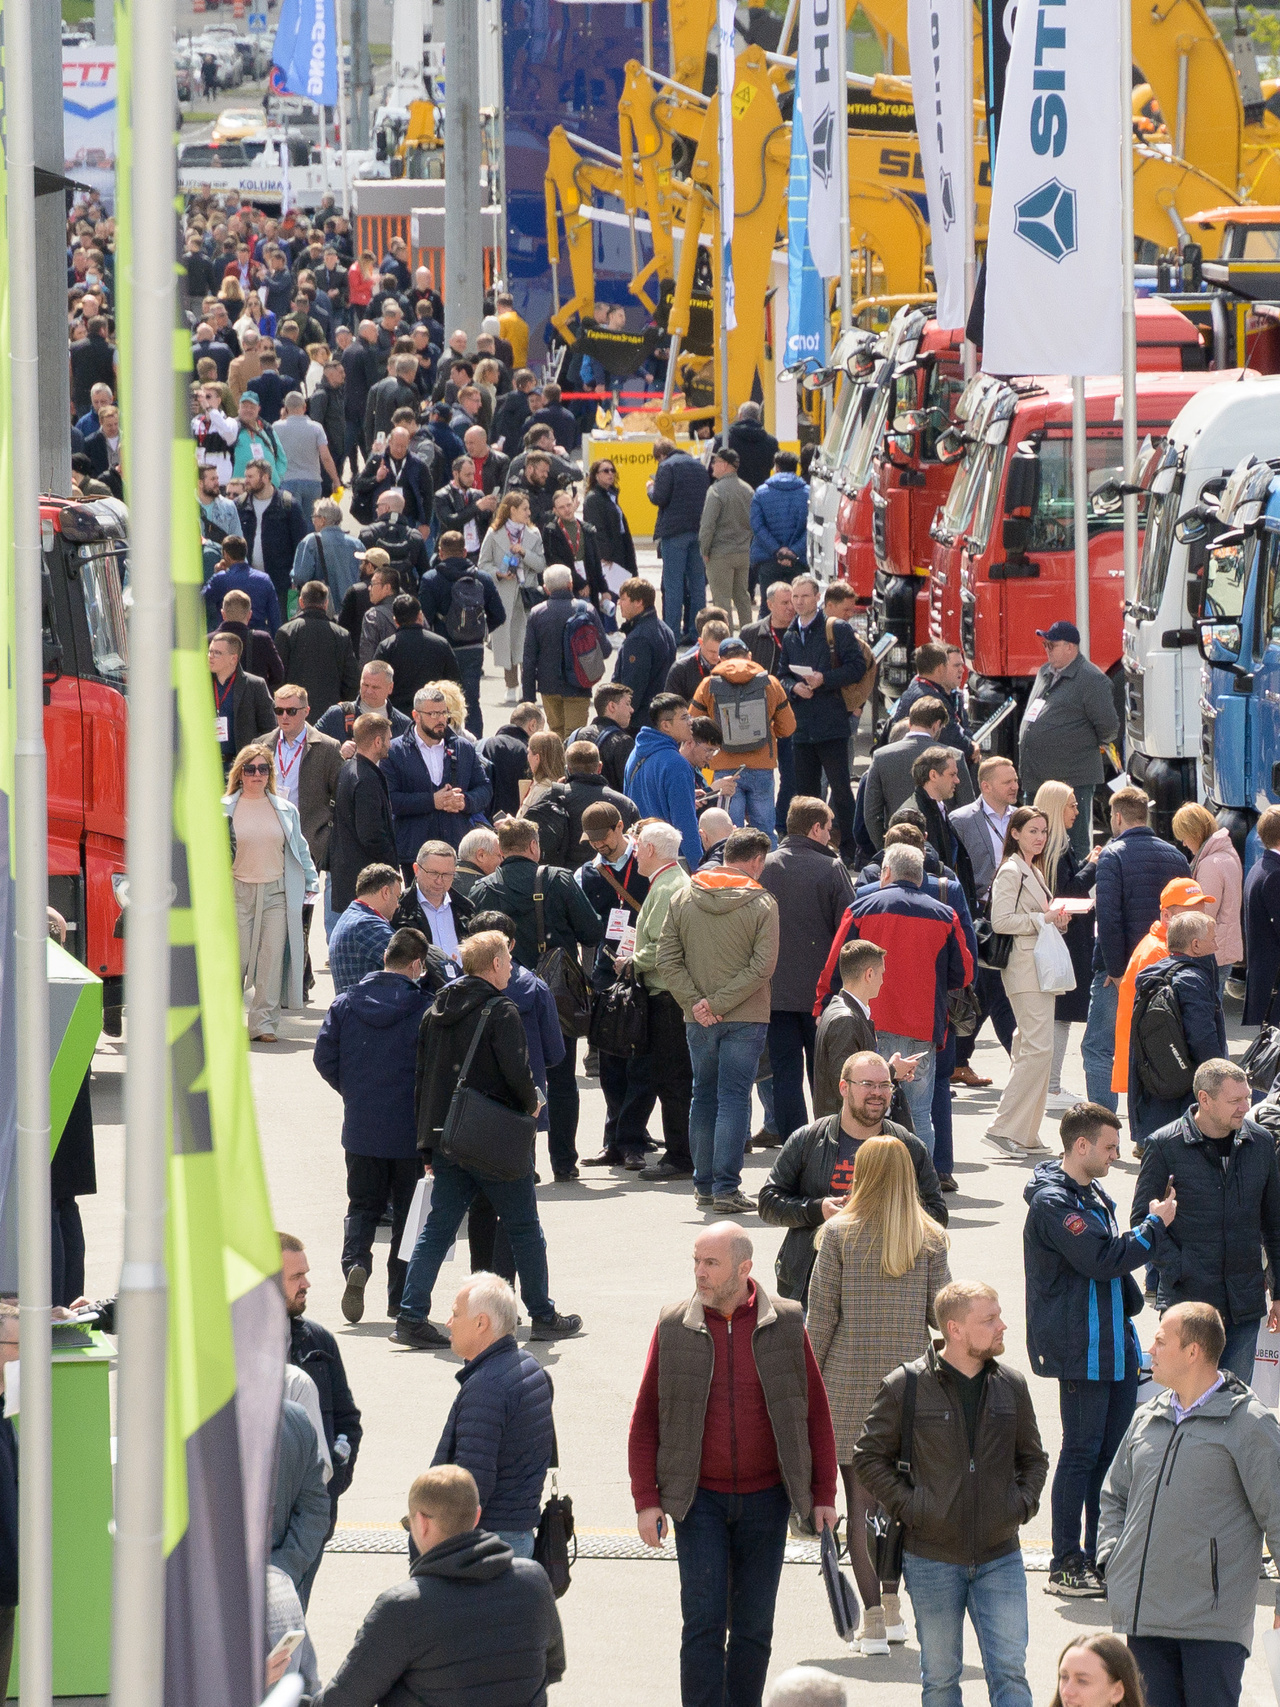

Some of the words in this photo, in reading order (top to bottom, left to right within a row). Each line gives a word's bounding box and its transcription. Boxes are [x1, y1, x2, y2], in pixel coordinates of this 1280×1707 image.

[1031, 0, 1067, 158] SIT
[240, 180, 291, 191] KOLUMA
[611, 454, 657, 465] ИНФОР
